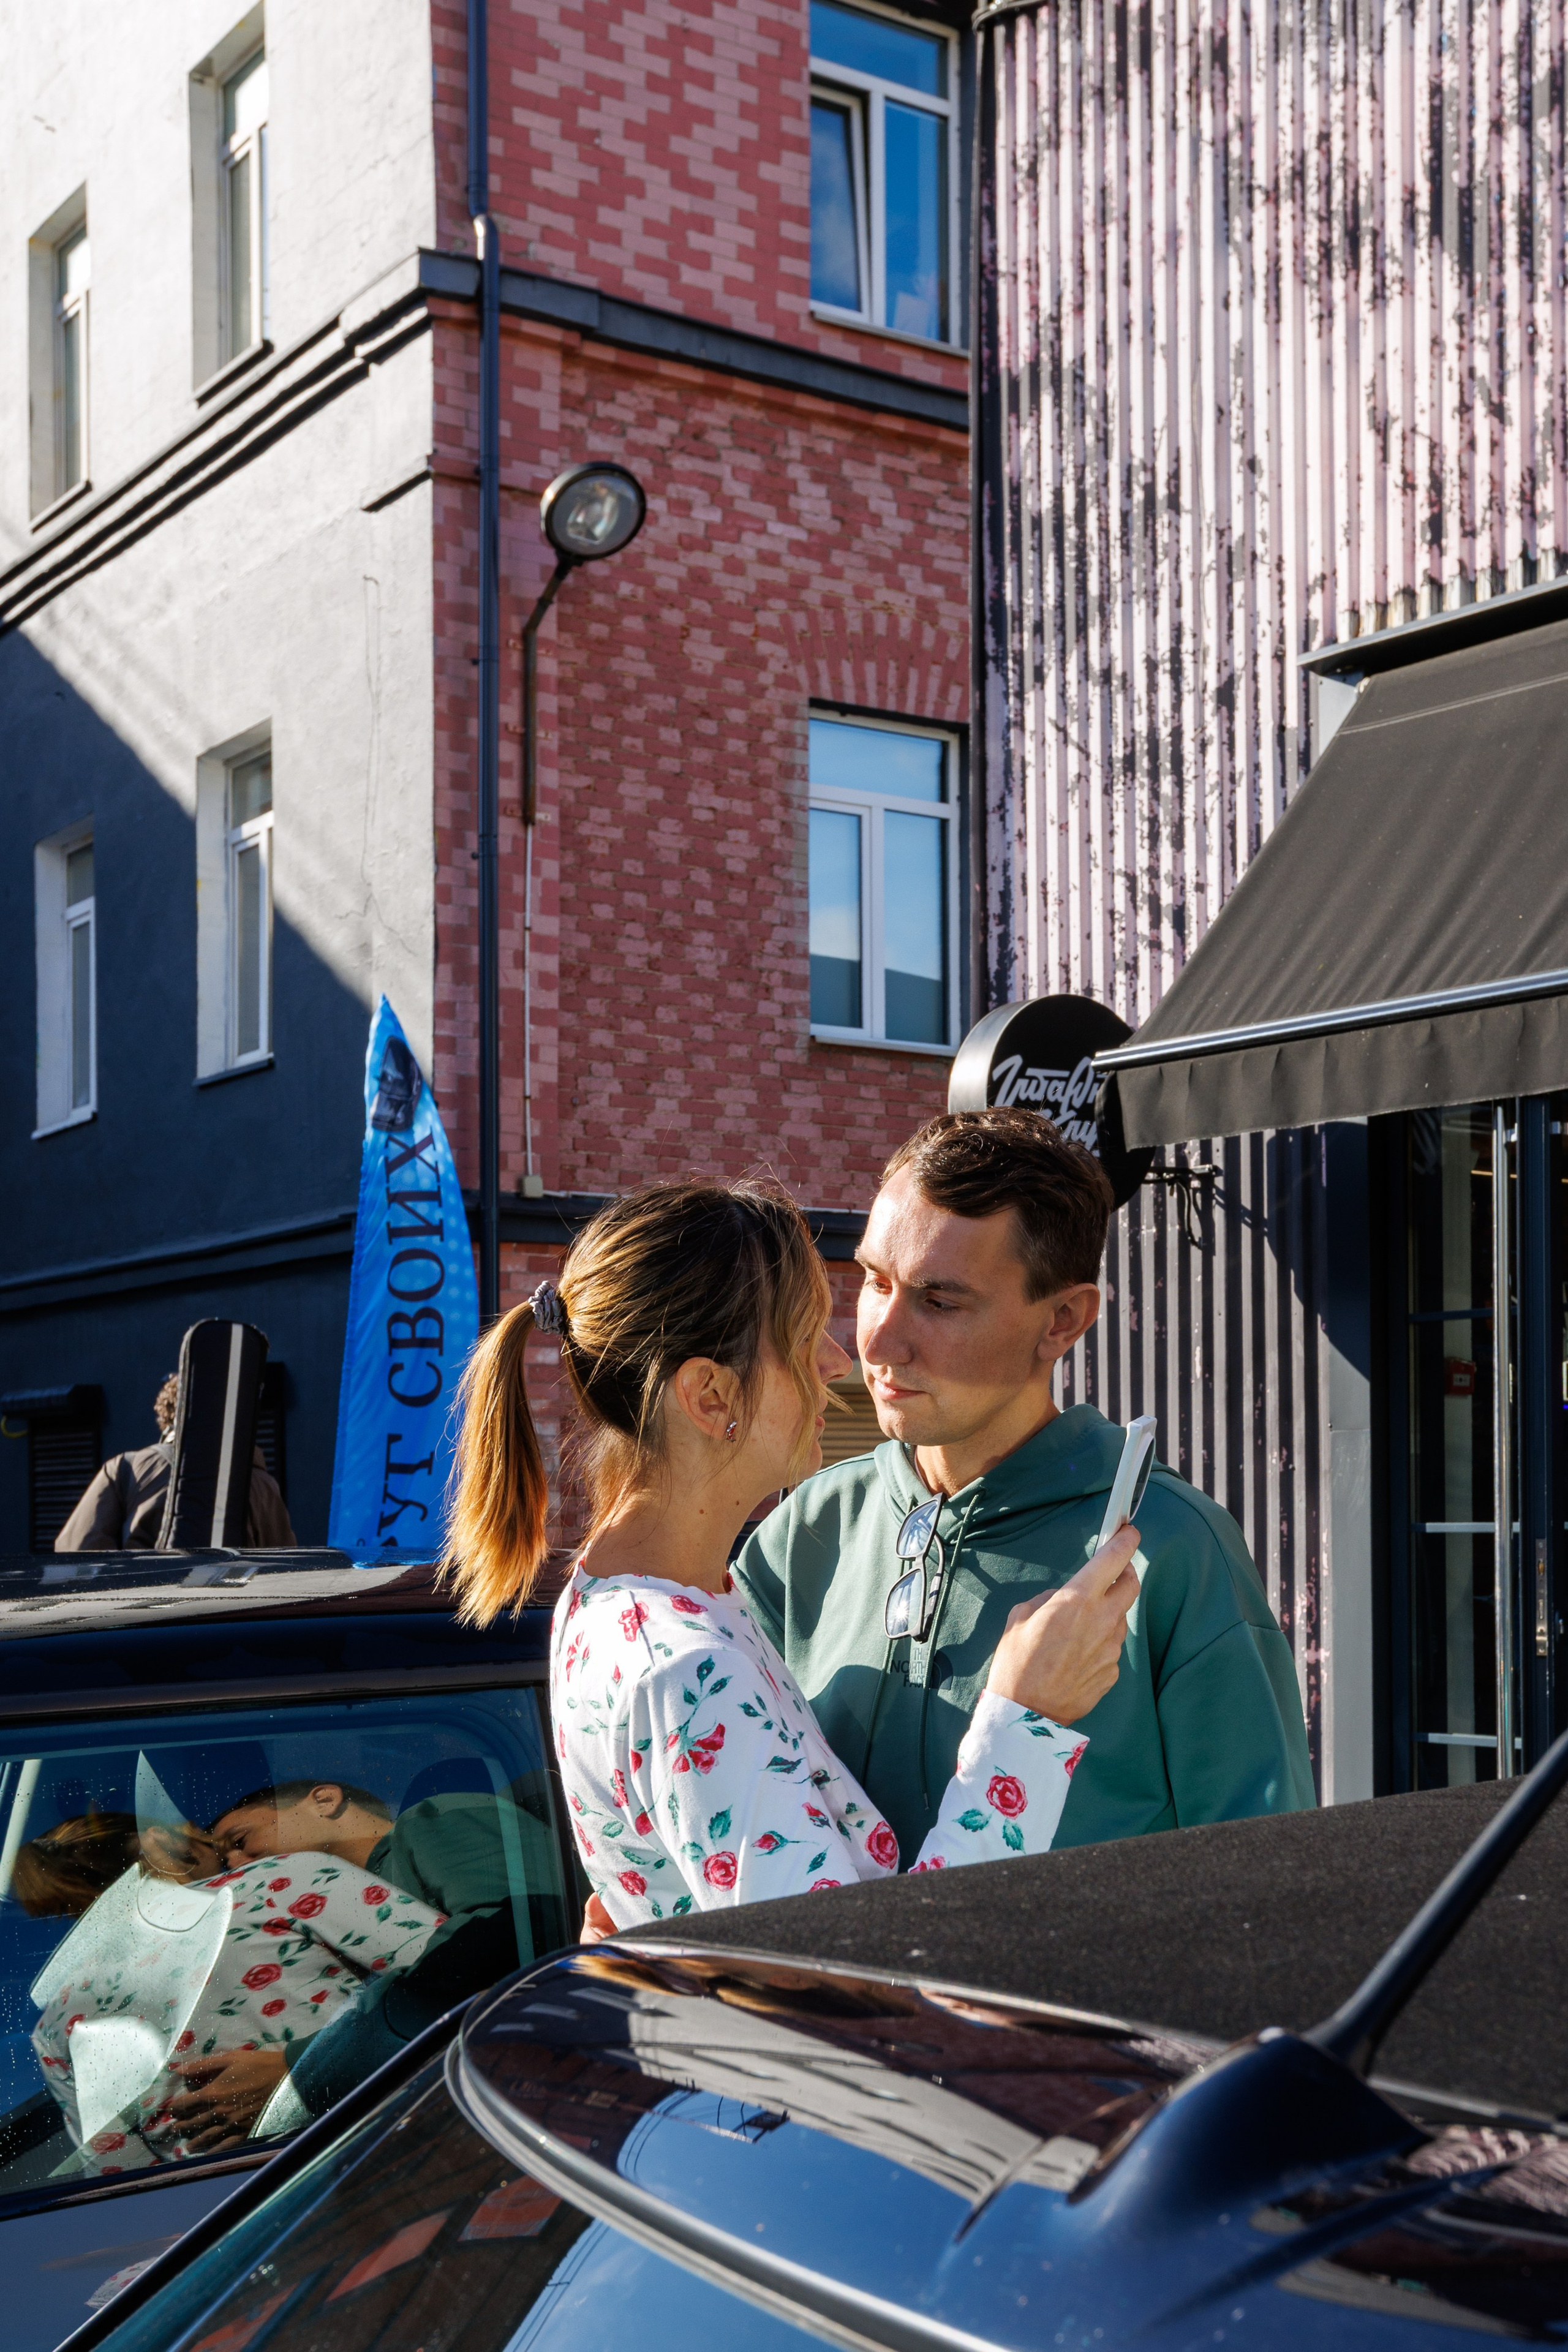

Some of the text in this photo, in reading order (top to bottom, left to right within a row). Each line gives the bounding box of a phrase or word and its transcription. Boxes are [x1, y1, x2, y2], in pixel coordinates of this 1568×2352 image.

[376, 1125, 445, 1546] УТ СВОИХ
[890, 1659, 927, 1674] NORTH
